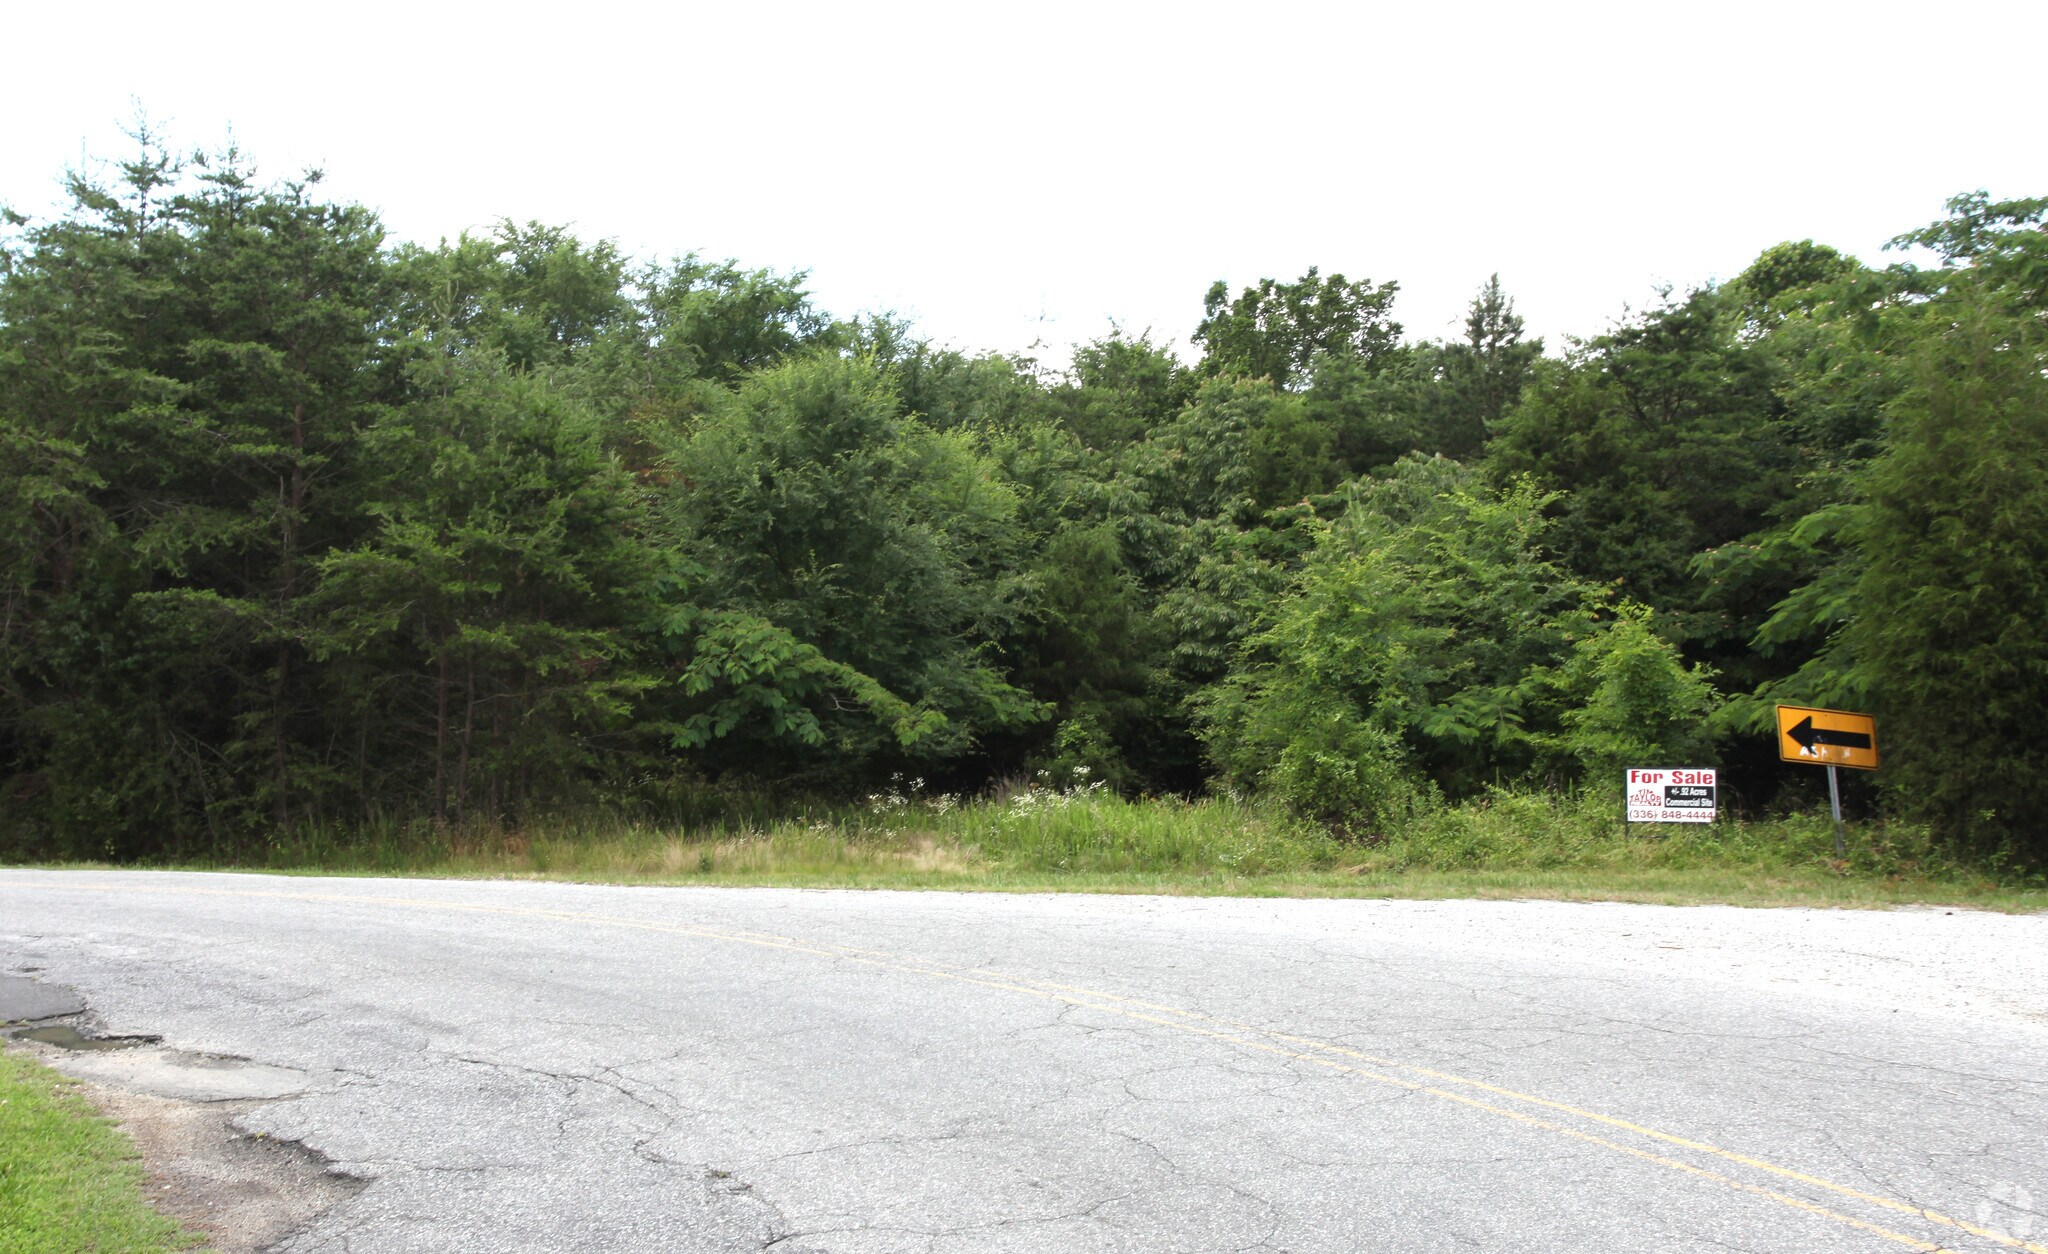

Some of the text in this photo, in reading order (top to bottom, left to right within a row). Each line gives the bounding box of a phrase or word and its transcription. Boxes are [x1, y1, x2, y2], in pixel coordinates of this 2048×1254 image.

[1631, 770, 1713, 784] For Sale
[1690, 788, 1707, 796] Acres
[1630, 793, 1662, 802] TAYLOR
[1665, 798, 1700, 807] Commercial
[1701, 798, 1713, 807] Site
[1629, 809, 1713, 819] (336) 848-4444
